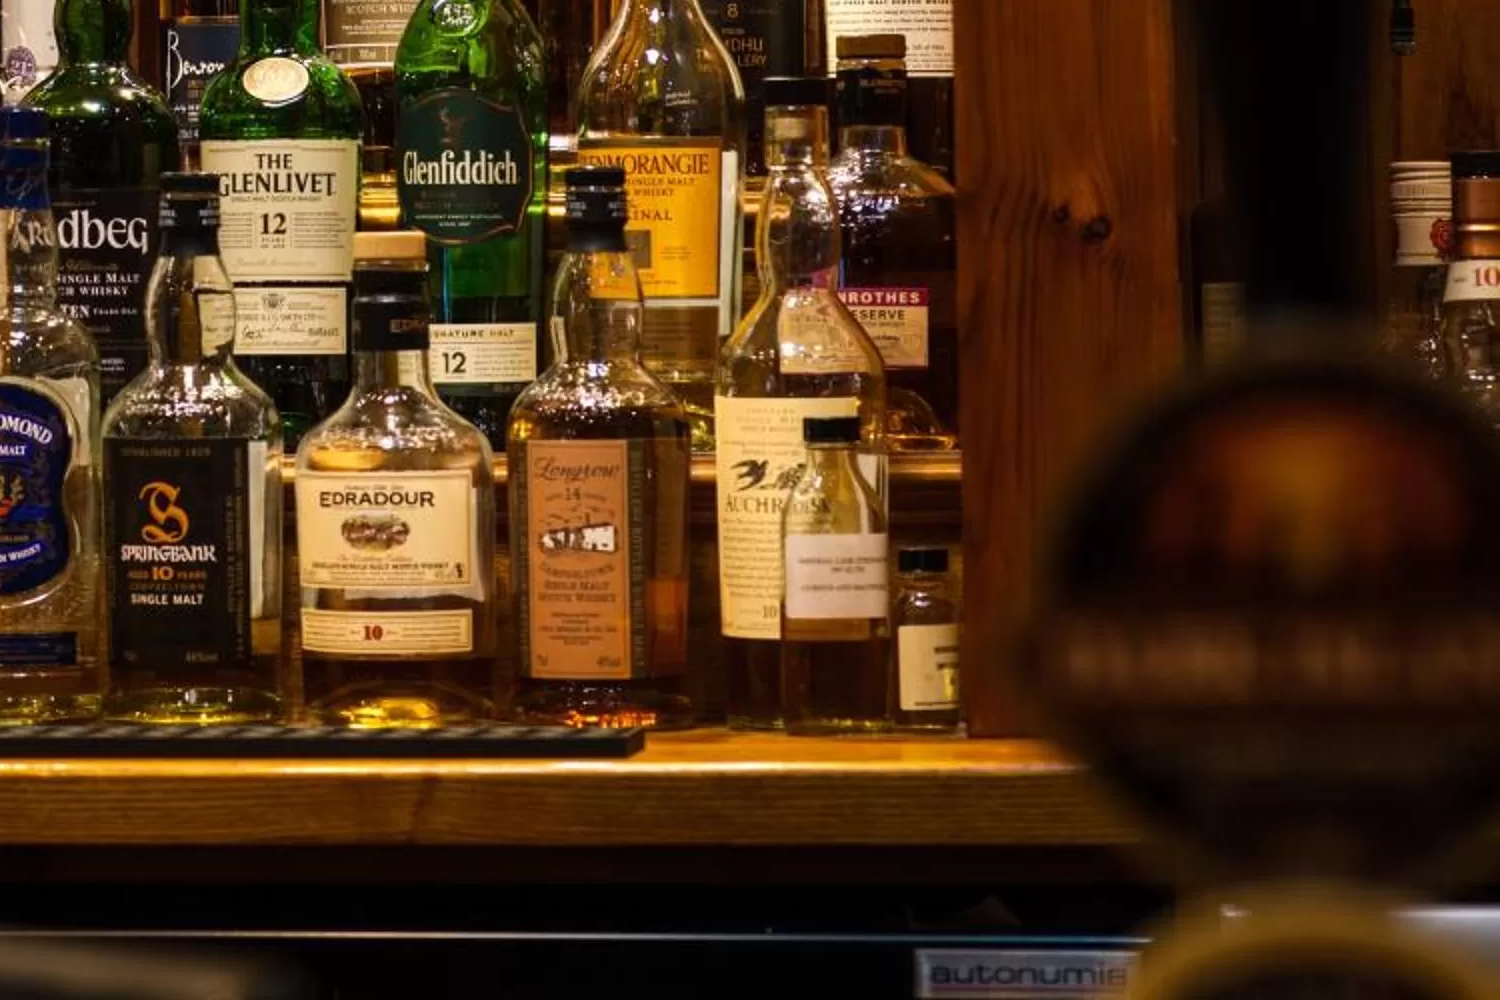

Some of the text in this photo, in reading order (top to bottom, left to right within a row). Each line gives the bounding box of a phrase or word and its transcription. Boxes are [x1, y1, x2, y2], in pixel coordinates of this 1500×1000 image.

[727, 3, 739, 18] 8
[255, 153, 293, 170] THE
[403, 150, 518, 185] Glenfiddich
[219, 172, 337, 197] GLENLIVET
[260, 212, 288, 235] 12
[106, 272, 141, 284] MALT
[80, 285, 129, 297] WHISKY
[60, 303, 91, 319] TEN
[442, 351, 467, 374] 12
[0, 444, 28, 456] MALT
[319, 490, 436, 508] EDRADOUR
[152, 565, 174, 581] 10
[131, 592, 204, 606] SINGLE MALT
[763, 605, 778, 618] 10
[363, 625, 384, 642] 10
